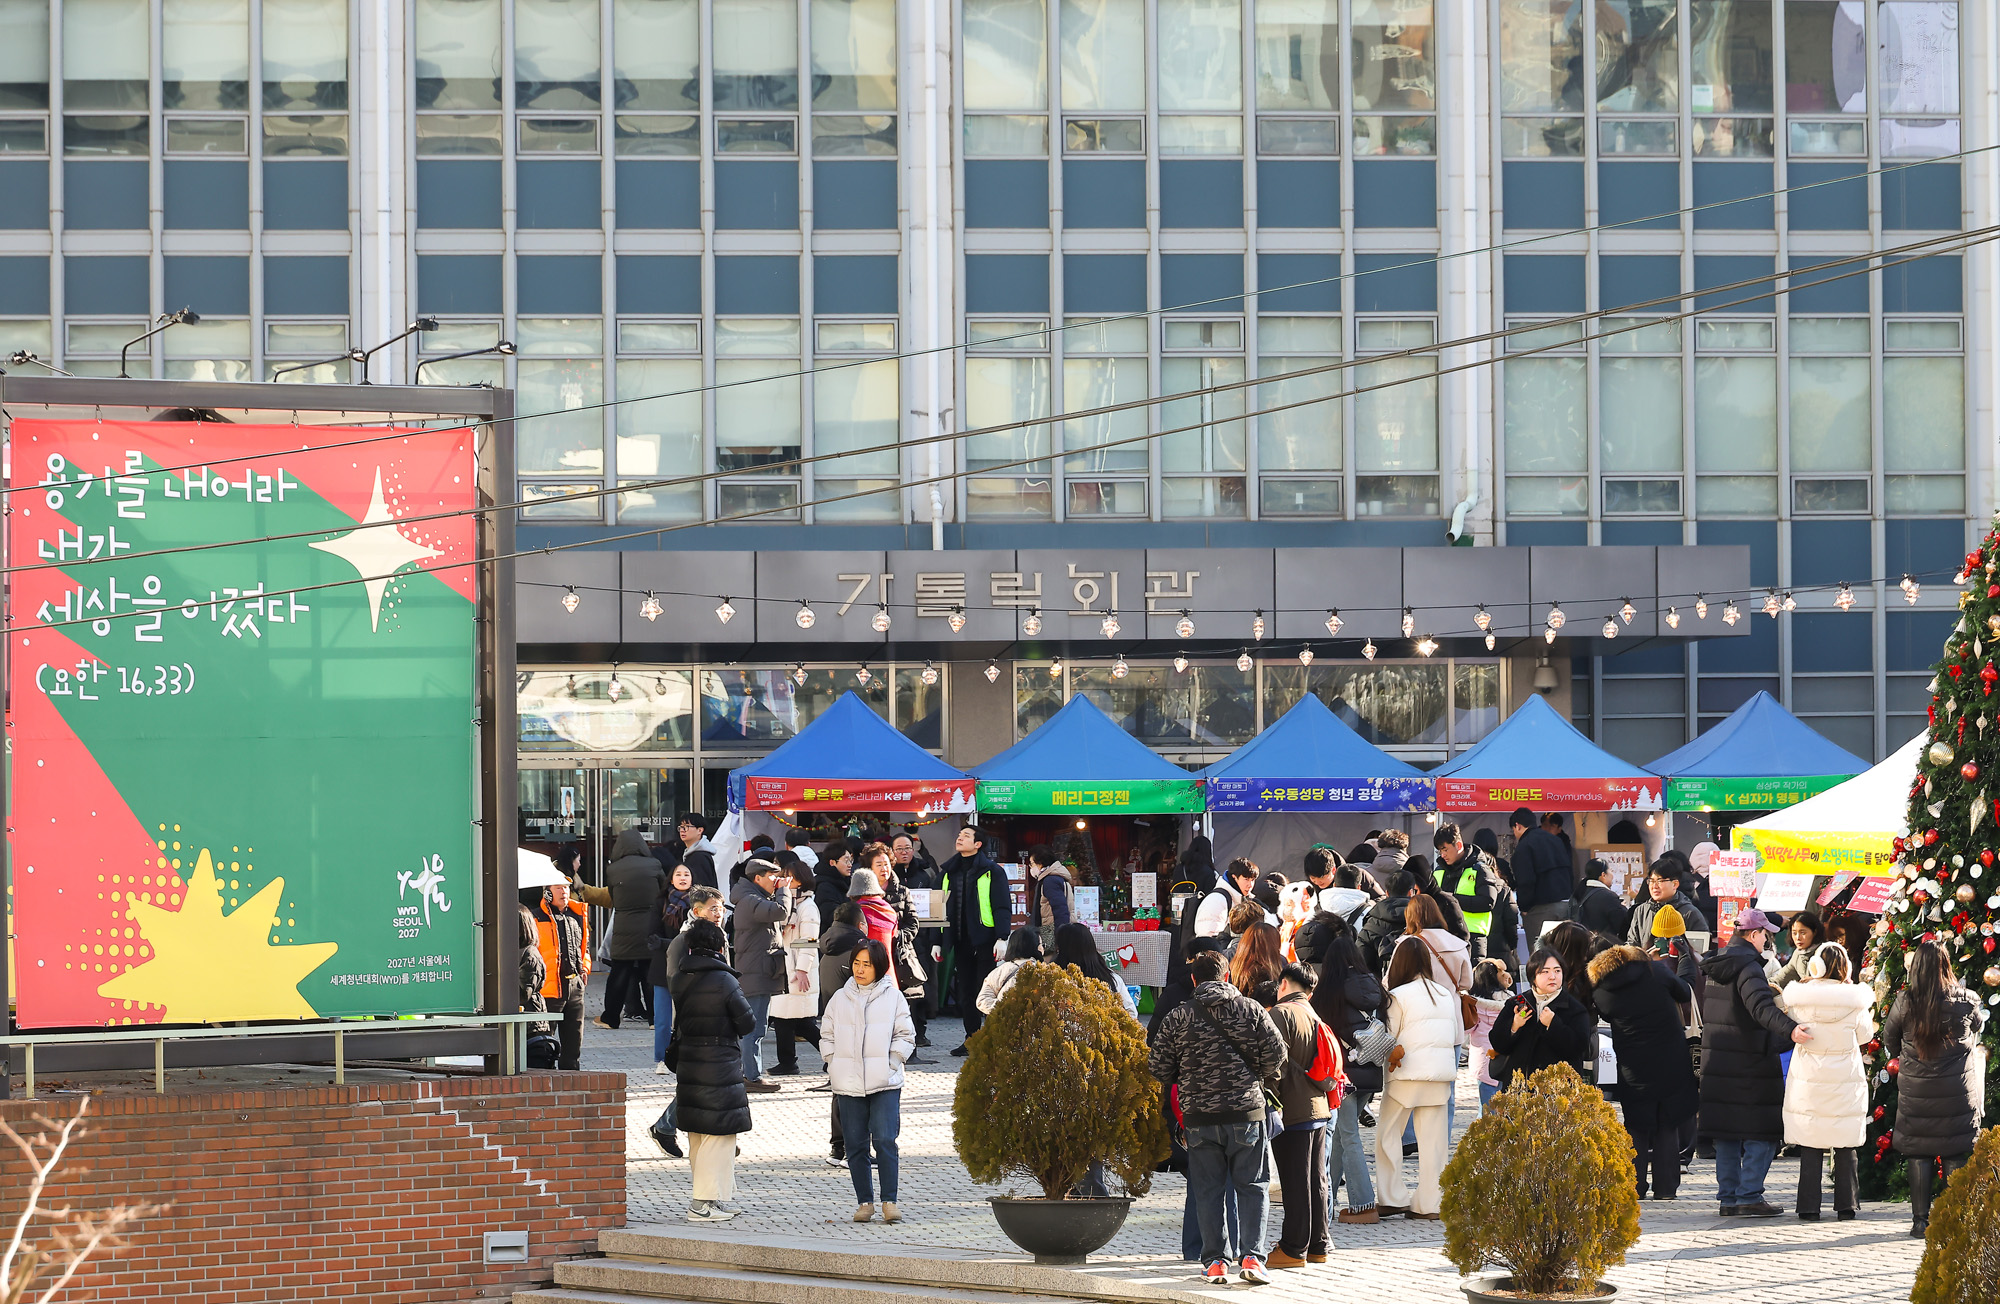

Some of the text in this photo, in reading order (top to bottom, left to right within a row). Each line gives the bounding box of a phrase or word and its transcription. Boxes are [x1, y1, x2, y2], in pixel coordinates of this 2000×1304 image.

[38, 450, 299, 520] 용기를 내어라
[38, 525, 132, 562] 내가
[837, 563, 1200, 617] 가톨릭회관
[36, 575, 310, 643] 세상을 이겼다
[35, 658, 196, 701] (요한 16,33)
[1783, 780, 1808, 790] 작가의
[847, 792, 883, 801] 우리나라
[884, 792, 912, 801] K성물
[1051, 789, 1130, 806] 메리그정젠
[1260, 787, 1384, 802] 수유동성당 청년 공방
[1488, 787, 1603, 803] 라이문도 Raymundus
[1725, 793, 1735, 805] K
[1738, 792, 1774, 805] 십자가
[622, 816, 672, 826] 가톨릭회관
[1720, 857, 1754, 868] 만족도 조사
[1764, 845, 1820, 863] 희망나무에
[1821, 848, 1872, 866] 소망카드를
[397, 906, 419, 916] WYD
[392, 917, 424, 927] SEOUL
[398, 929, 420, 939] 2027
[387, 954, 451, 969] 2027년 서울에서
[329, 970, 453, 986] 세계청년대회(WYD)를 개최합니다
